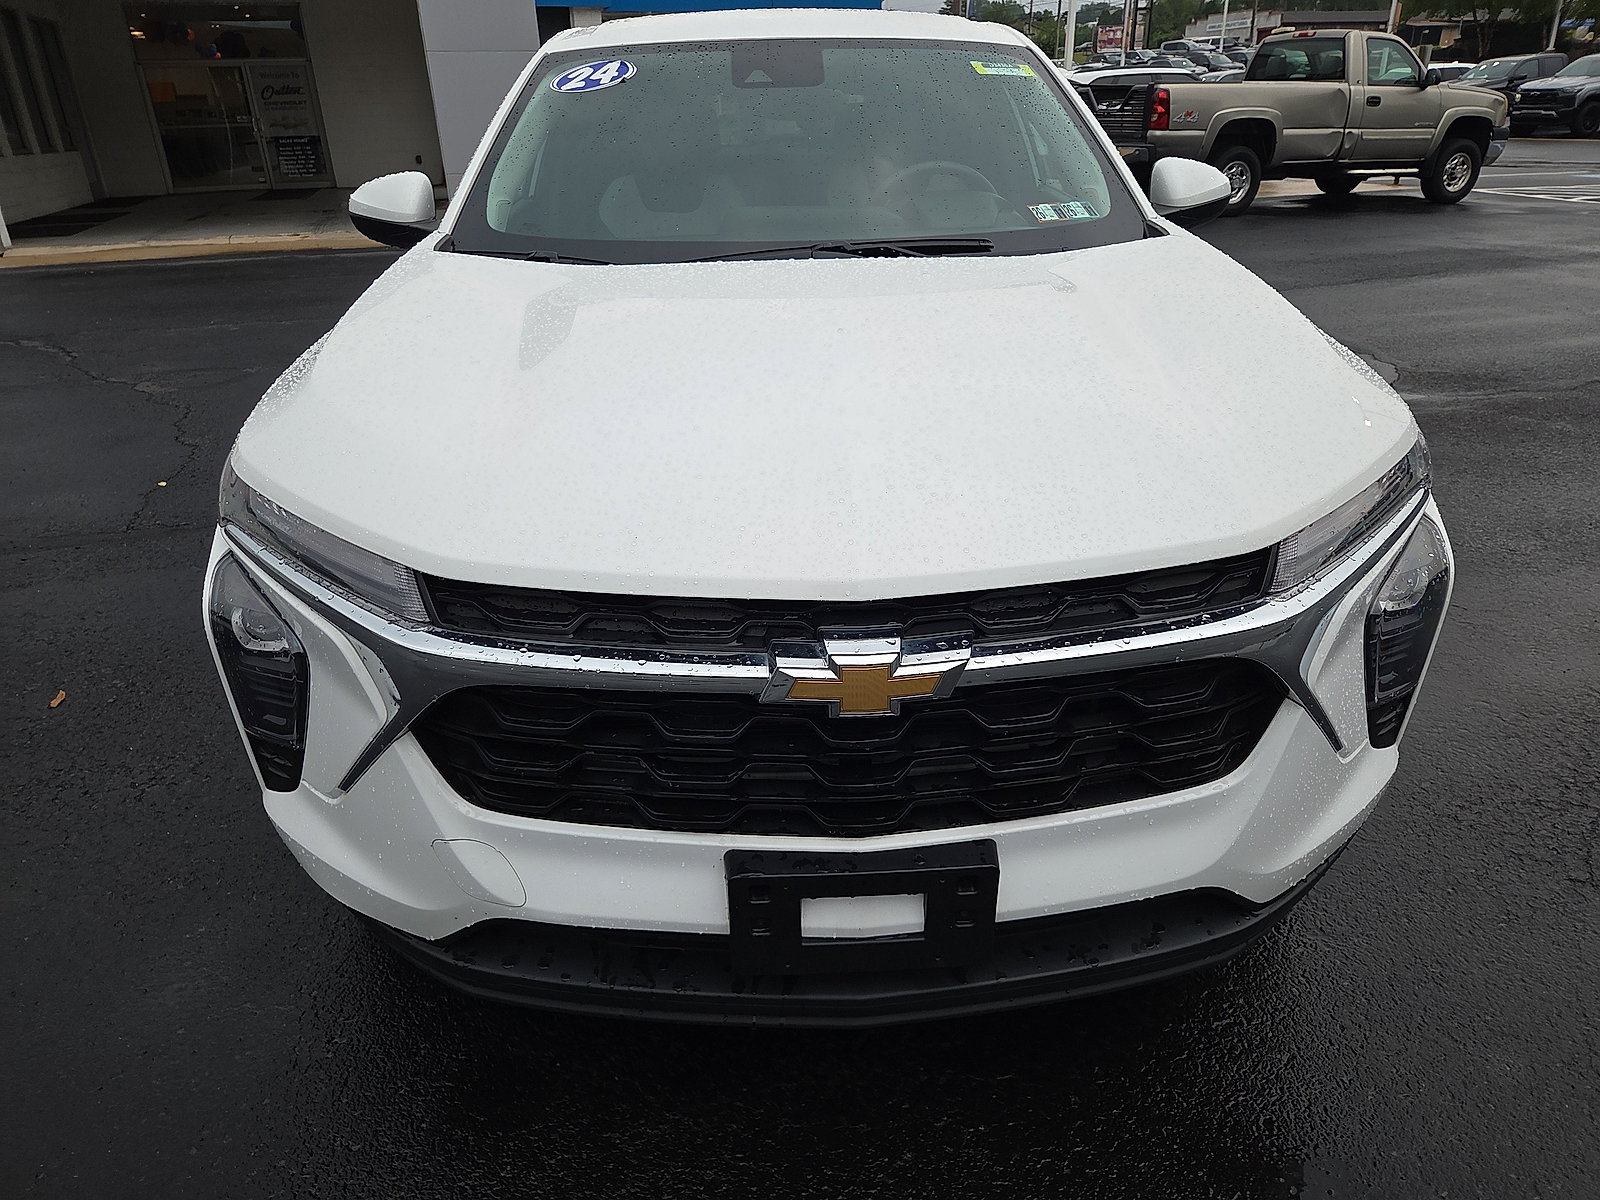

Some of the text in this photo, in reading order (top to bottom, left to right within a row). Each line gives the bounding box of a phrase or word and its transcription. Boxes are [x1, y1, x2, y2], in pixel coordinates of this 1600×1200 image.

[561, 60, 622, 90] 24
[1031, 207, 1046, 219] 26
[1063, 204, 1078, 217] 26
